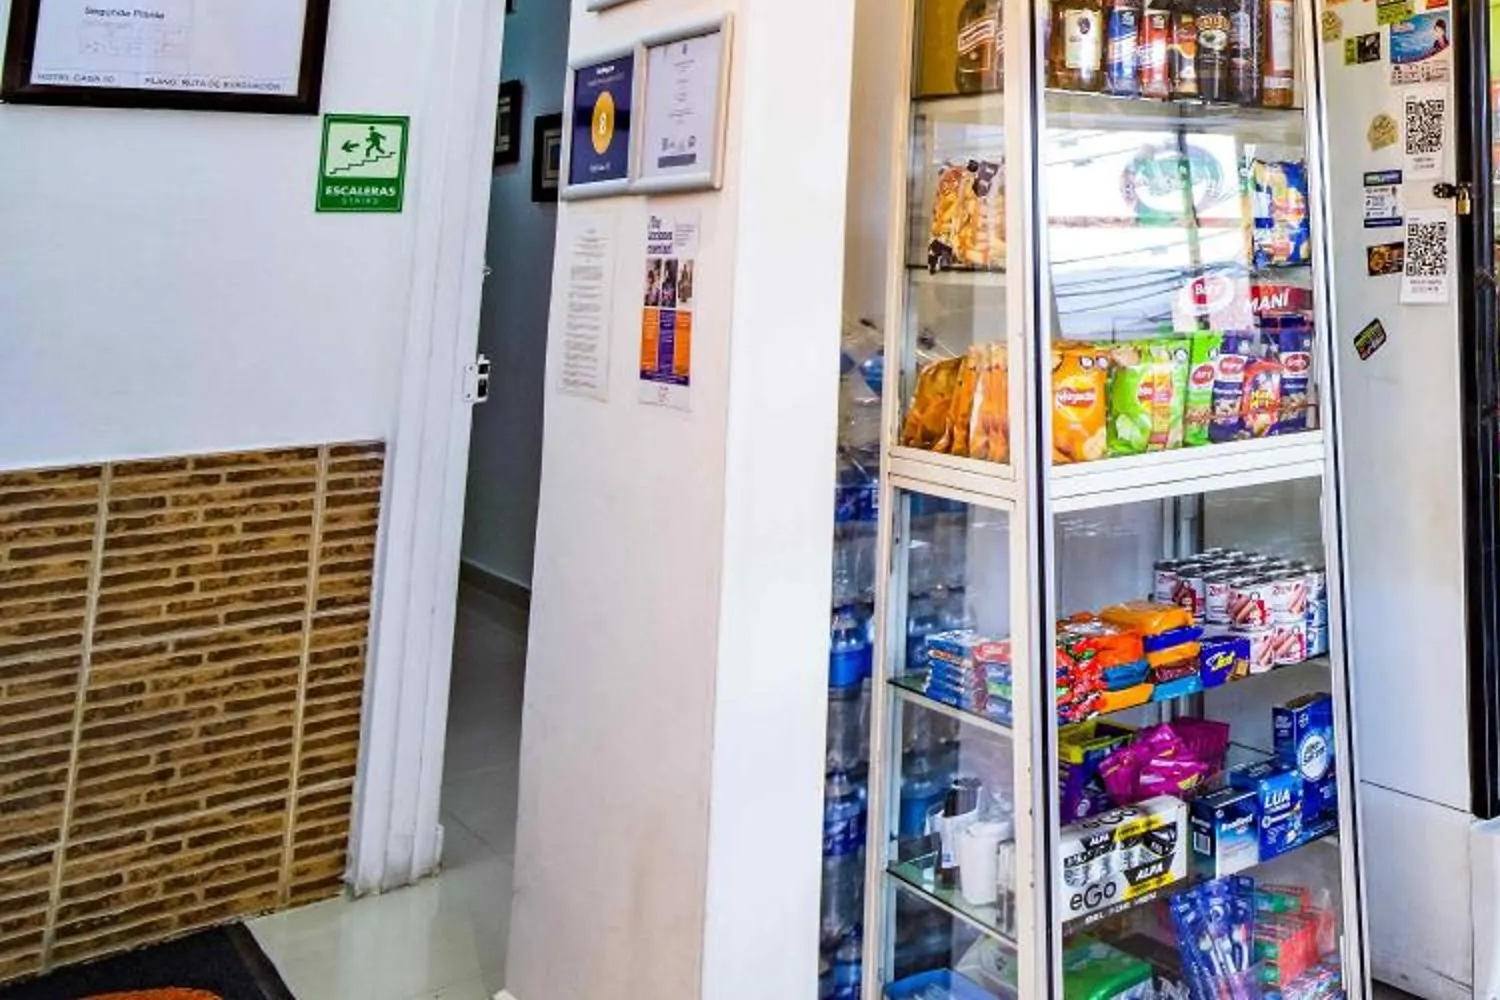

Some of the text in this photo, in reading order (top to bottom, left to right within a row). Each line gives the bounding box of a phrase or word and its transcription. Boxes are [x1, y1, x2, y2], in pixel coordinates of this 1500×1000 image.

[325, 185, 397, 197] ESCALERAS
[1264, 787, 1291, 809] LUA
[1069, 881, 1117, 911] eGo
